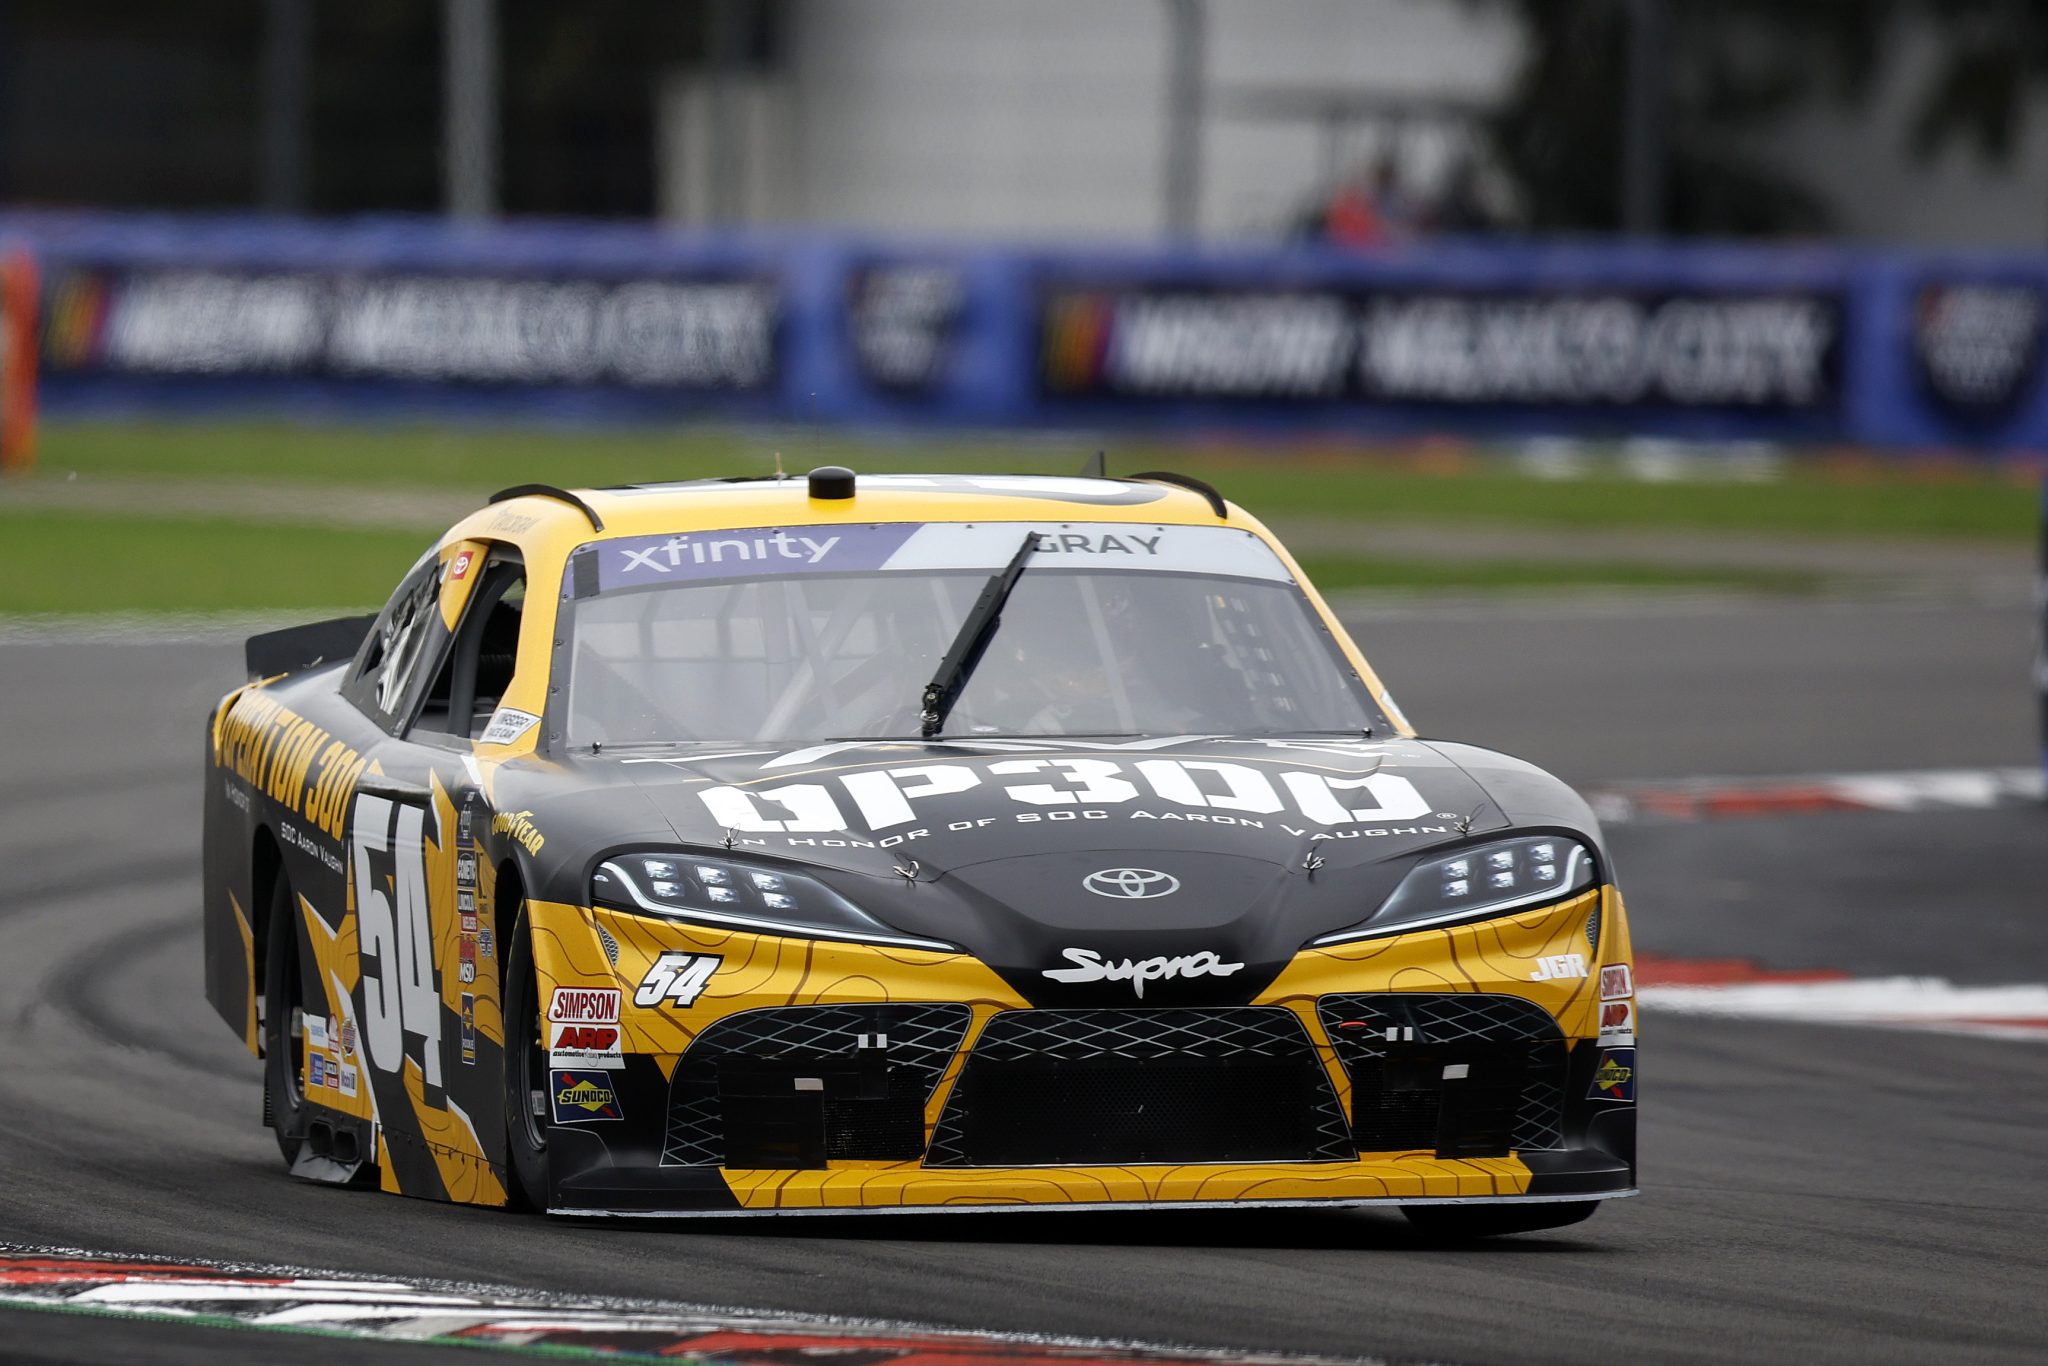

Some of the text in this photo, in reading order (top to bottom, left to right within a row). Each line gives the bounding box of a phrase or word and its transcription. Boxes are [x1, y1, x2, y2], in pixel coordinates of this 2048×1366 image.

[620, 532, 840, 572] xfinity
[1037, 533, 1160, 555] GRAY
[305, 740, 367, 842] 300
[789, 827, 932, 849] HONOR
[948, 816, 997, 832] OF
[1017, 810, 1109, 824] SOC
[1130, 810, 1264, 829] AARON
[1280, 823, 1446, 840] VAUGHN
[353, 792, 442, 1088] 54
[634, 952, 723, 1008] 54
[1042, 947, 1245, 999] Supra
[1529, 954, 1588, 982] JGR
[554, 991, 617, 1020] SIMPSON
[554, 1026, 618, 1050] ARP
[560, 1089, 611, 1104] SUNOCO
